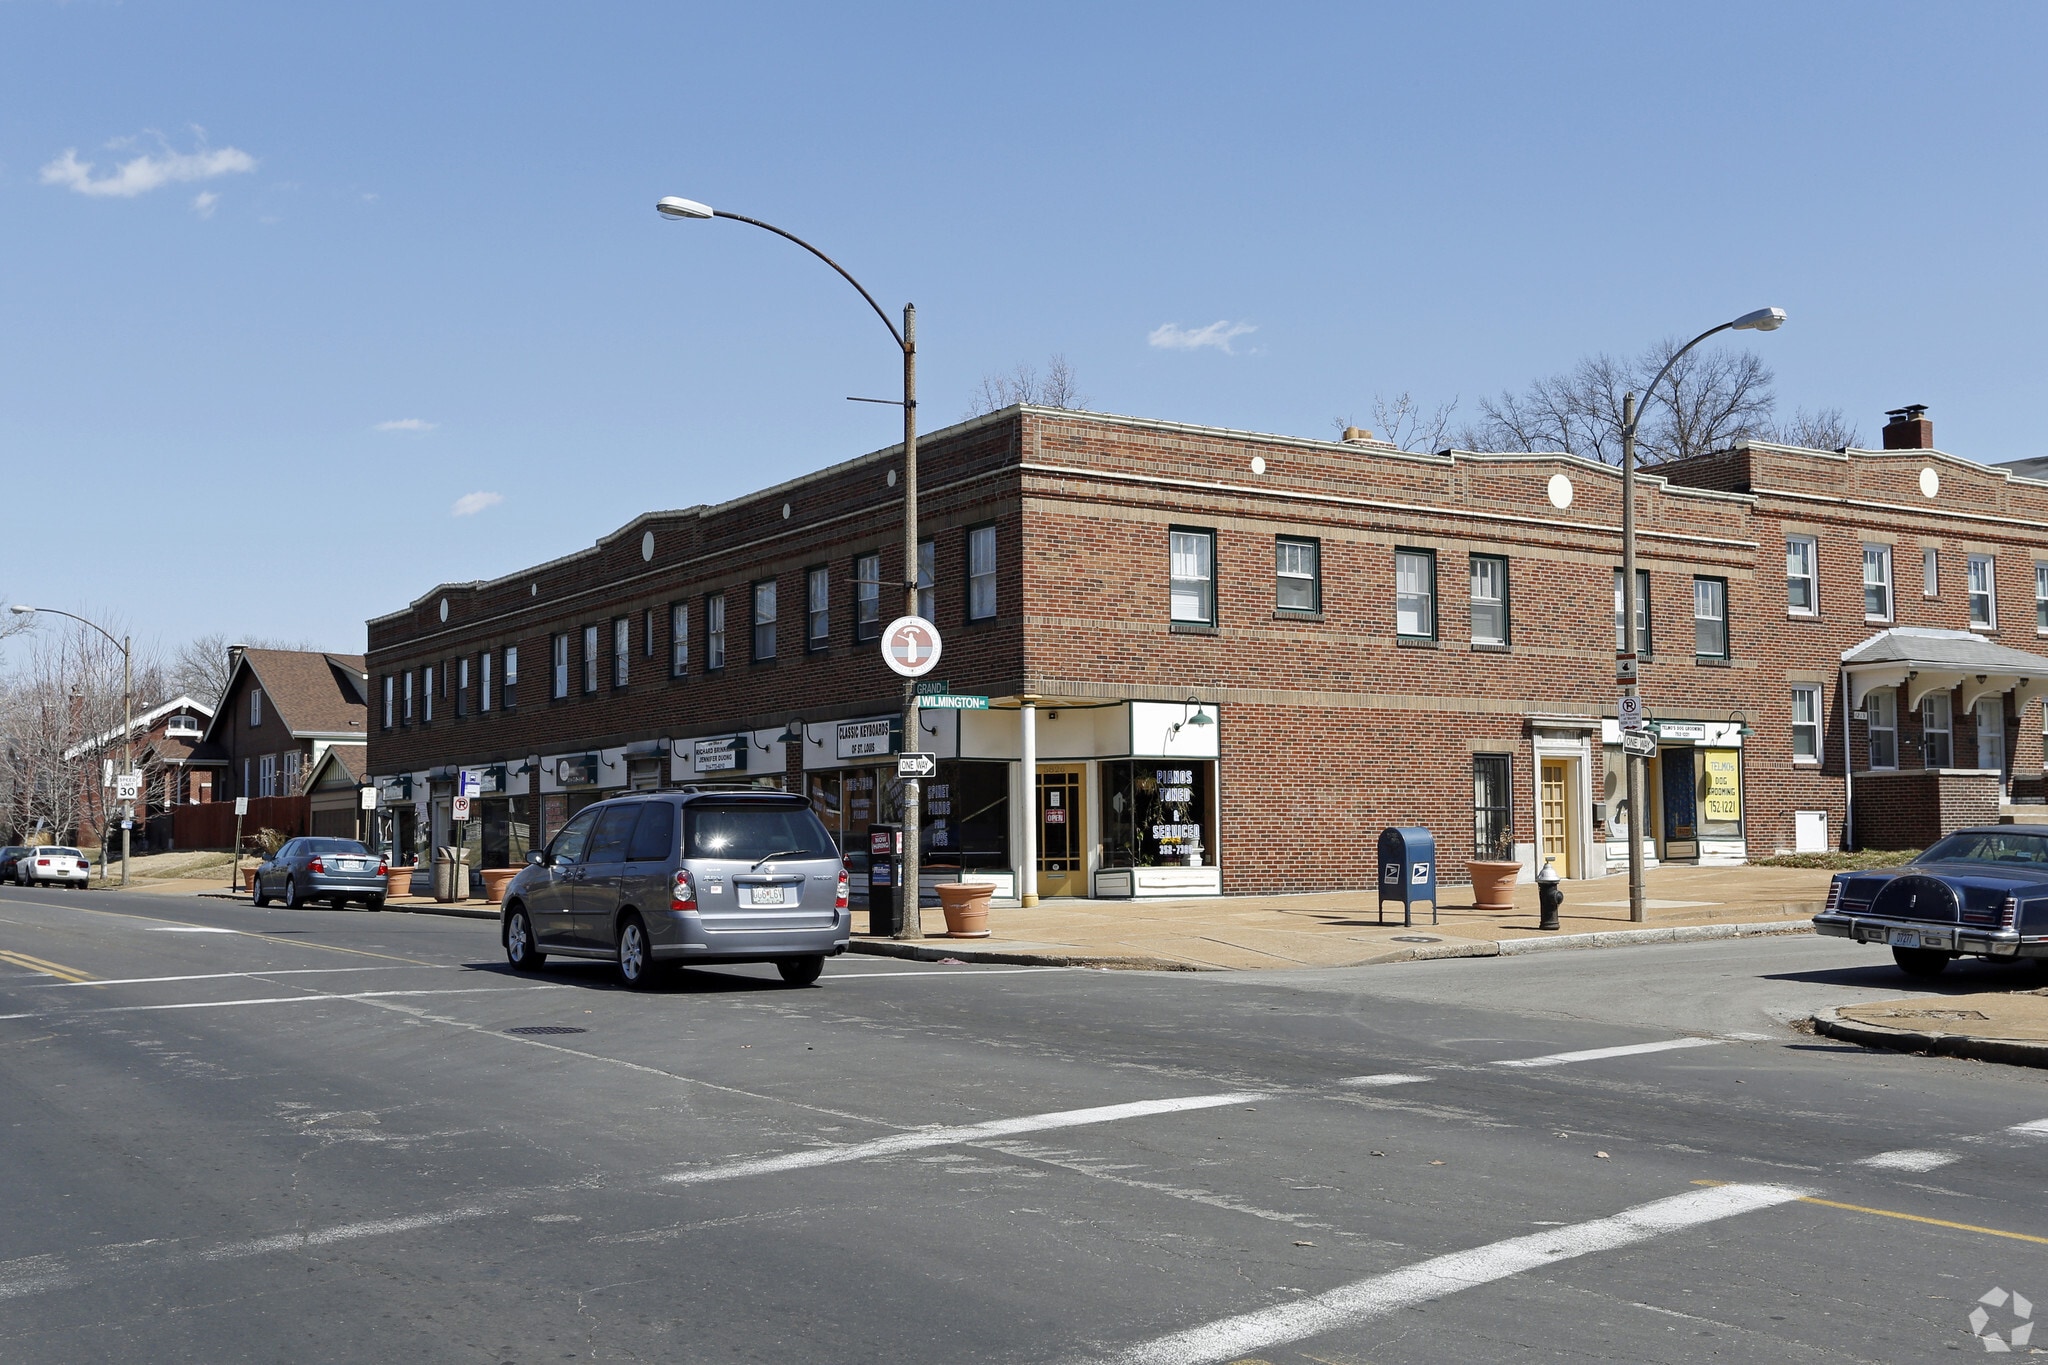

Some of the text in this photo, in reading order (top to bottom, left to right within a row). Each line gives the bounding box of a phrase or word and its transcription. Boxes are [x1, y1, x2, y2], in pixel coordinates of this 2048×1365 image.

[917, 682, 941, 694] GRAND
[922, 696, 979, 708] WILMINGTON
[839, 722, 888, 740] CLASSIC KEYBOARDS
[852, 744, 857, 754] OF
[864, 742, 875, 753] LOUIS
[1627, 737, 1651, 749] ONE WAY
[902, 760, 928, 770] ONE WAY
[1156, 770, 1193, 784] PIANOS
[1715, 776, 1727, 785] DOG
[120, 787, 134, 796] 30
[1159, 788, 1191, 802] TUNED
[1707, 787, 1735, 796] GROOMING
[1709, 800, 1735, 812] 752-1221
[1173, 809, 1180, 822] &
[1152, 824, 1200, 839] SERVICED
